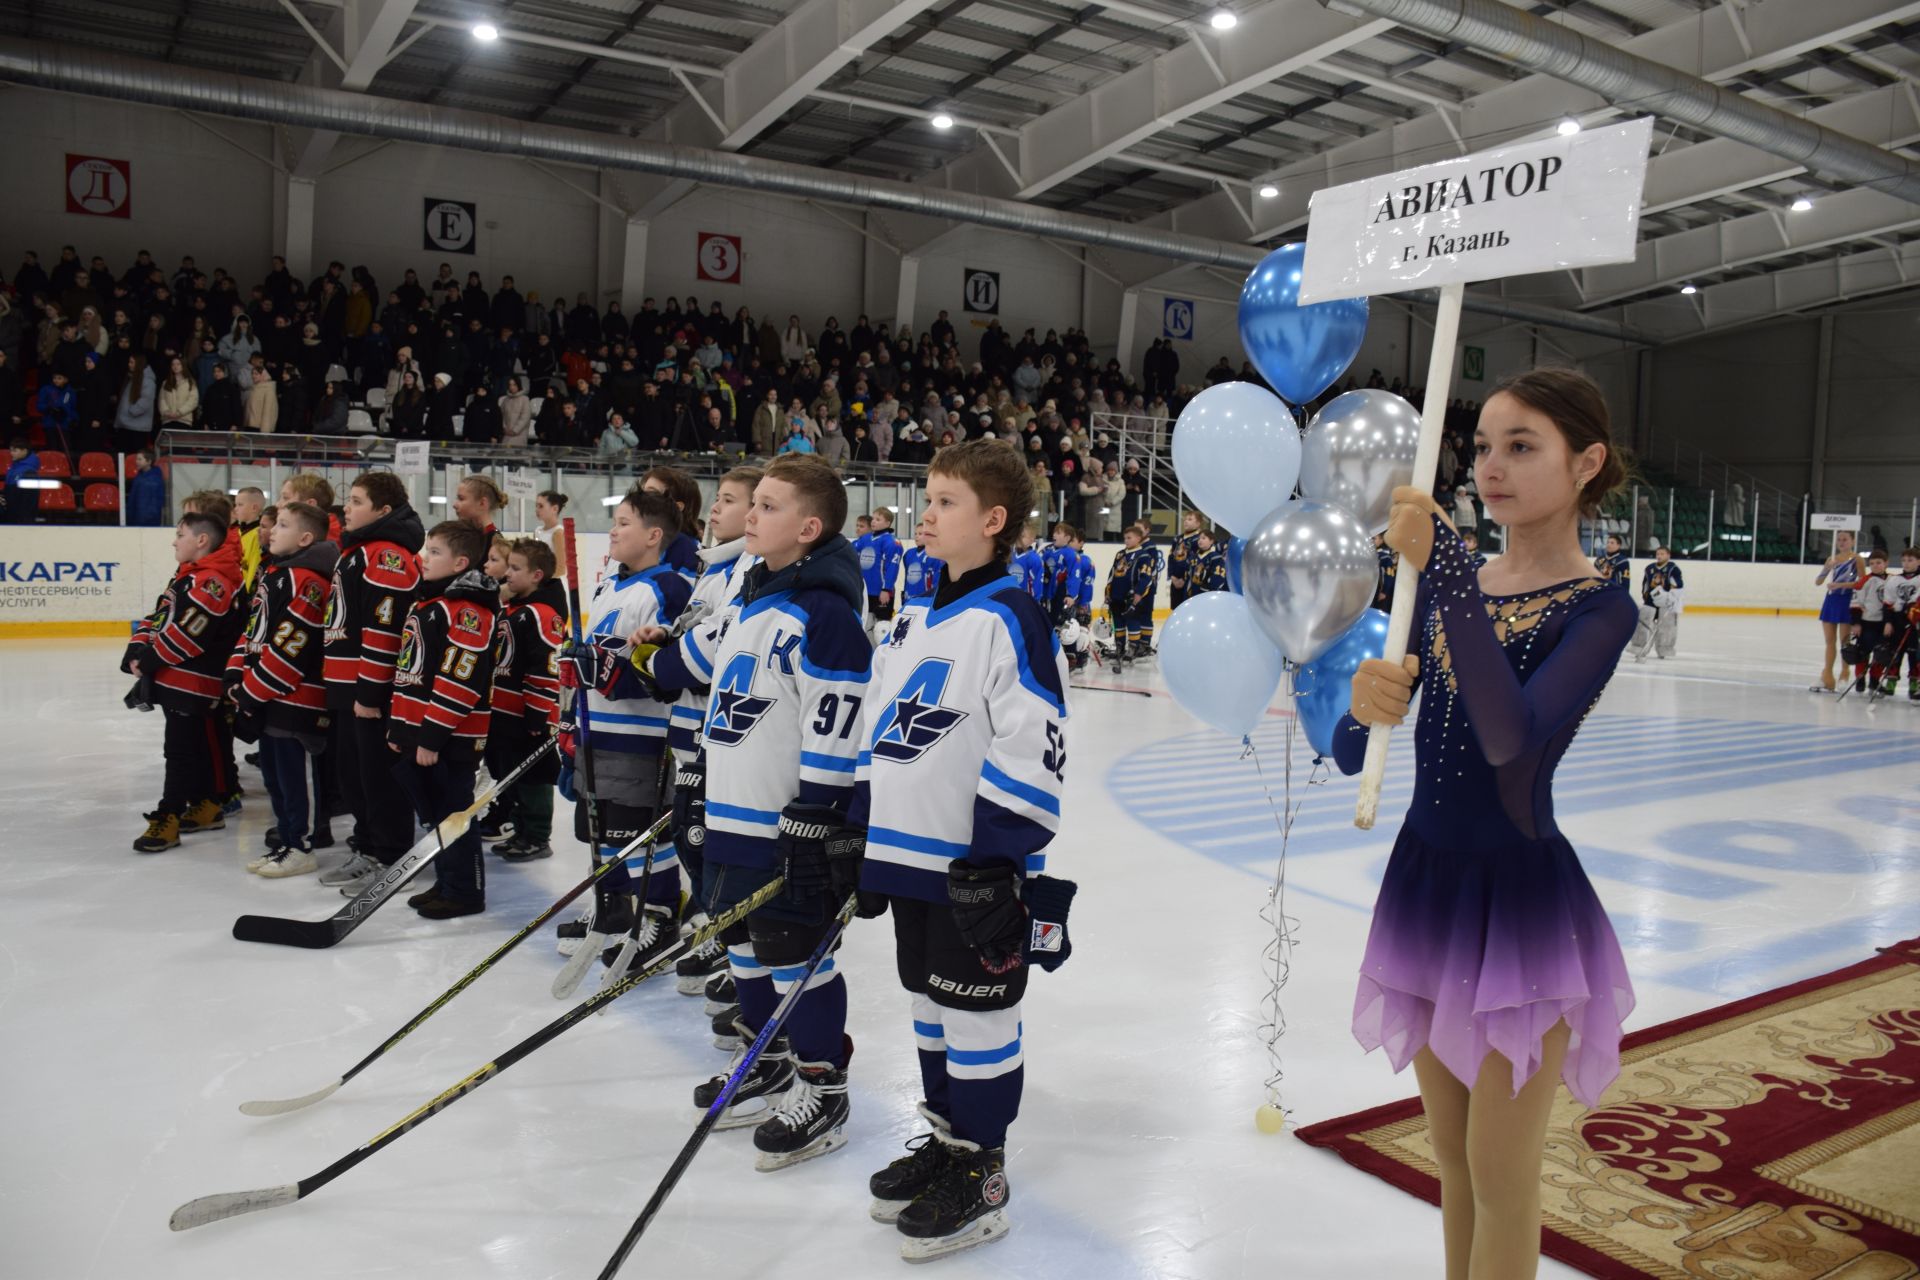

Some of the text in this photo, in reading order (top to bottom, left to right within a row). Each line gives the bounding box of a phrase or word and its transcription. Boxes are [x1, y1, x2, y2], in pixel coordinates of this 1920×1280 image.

[81, 169, 116, 208] Д
[1373, 156, 1562, 223] АВИАТОР
[437, 210, 462, 242] Е
[1402, 230, 1510, 262] г. Казань
[972, 279, 992, 305] И
[1172, 308, 1188, 330] К
[0, 562, 120, 582] КАРАТ
[0, 597, 46, 608] УСЛУГИ
[375, 596, 394, 625] 4
[179, 606, 209, 637] 10
[273, 620, 308, 657] 22
[440, 645, 478, 680] 15
[813, 692, 861, 739] 97
[1042, 719, 1066, 784] 52
[606, 829, 638, 838] CCM
[334, 855, 423, 921] VAPOR
[929, 973, 1007, 997] BAUER
